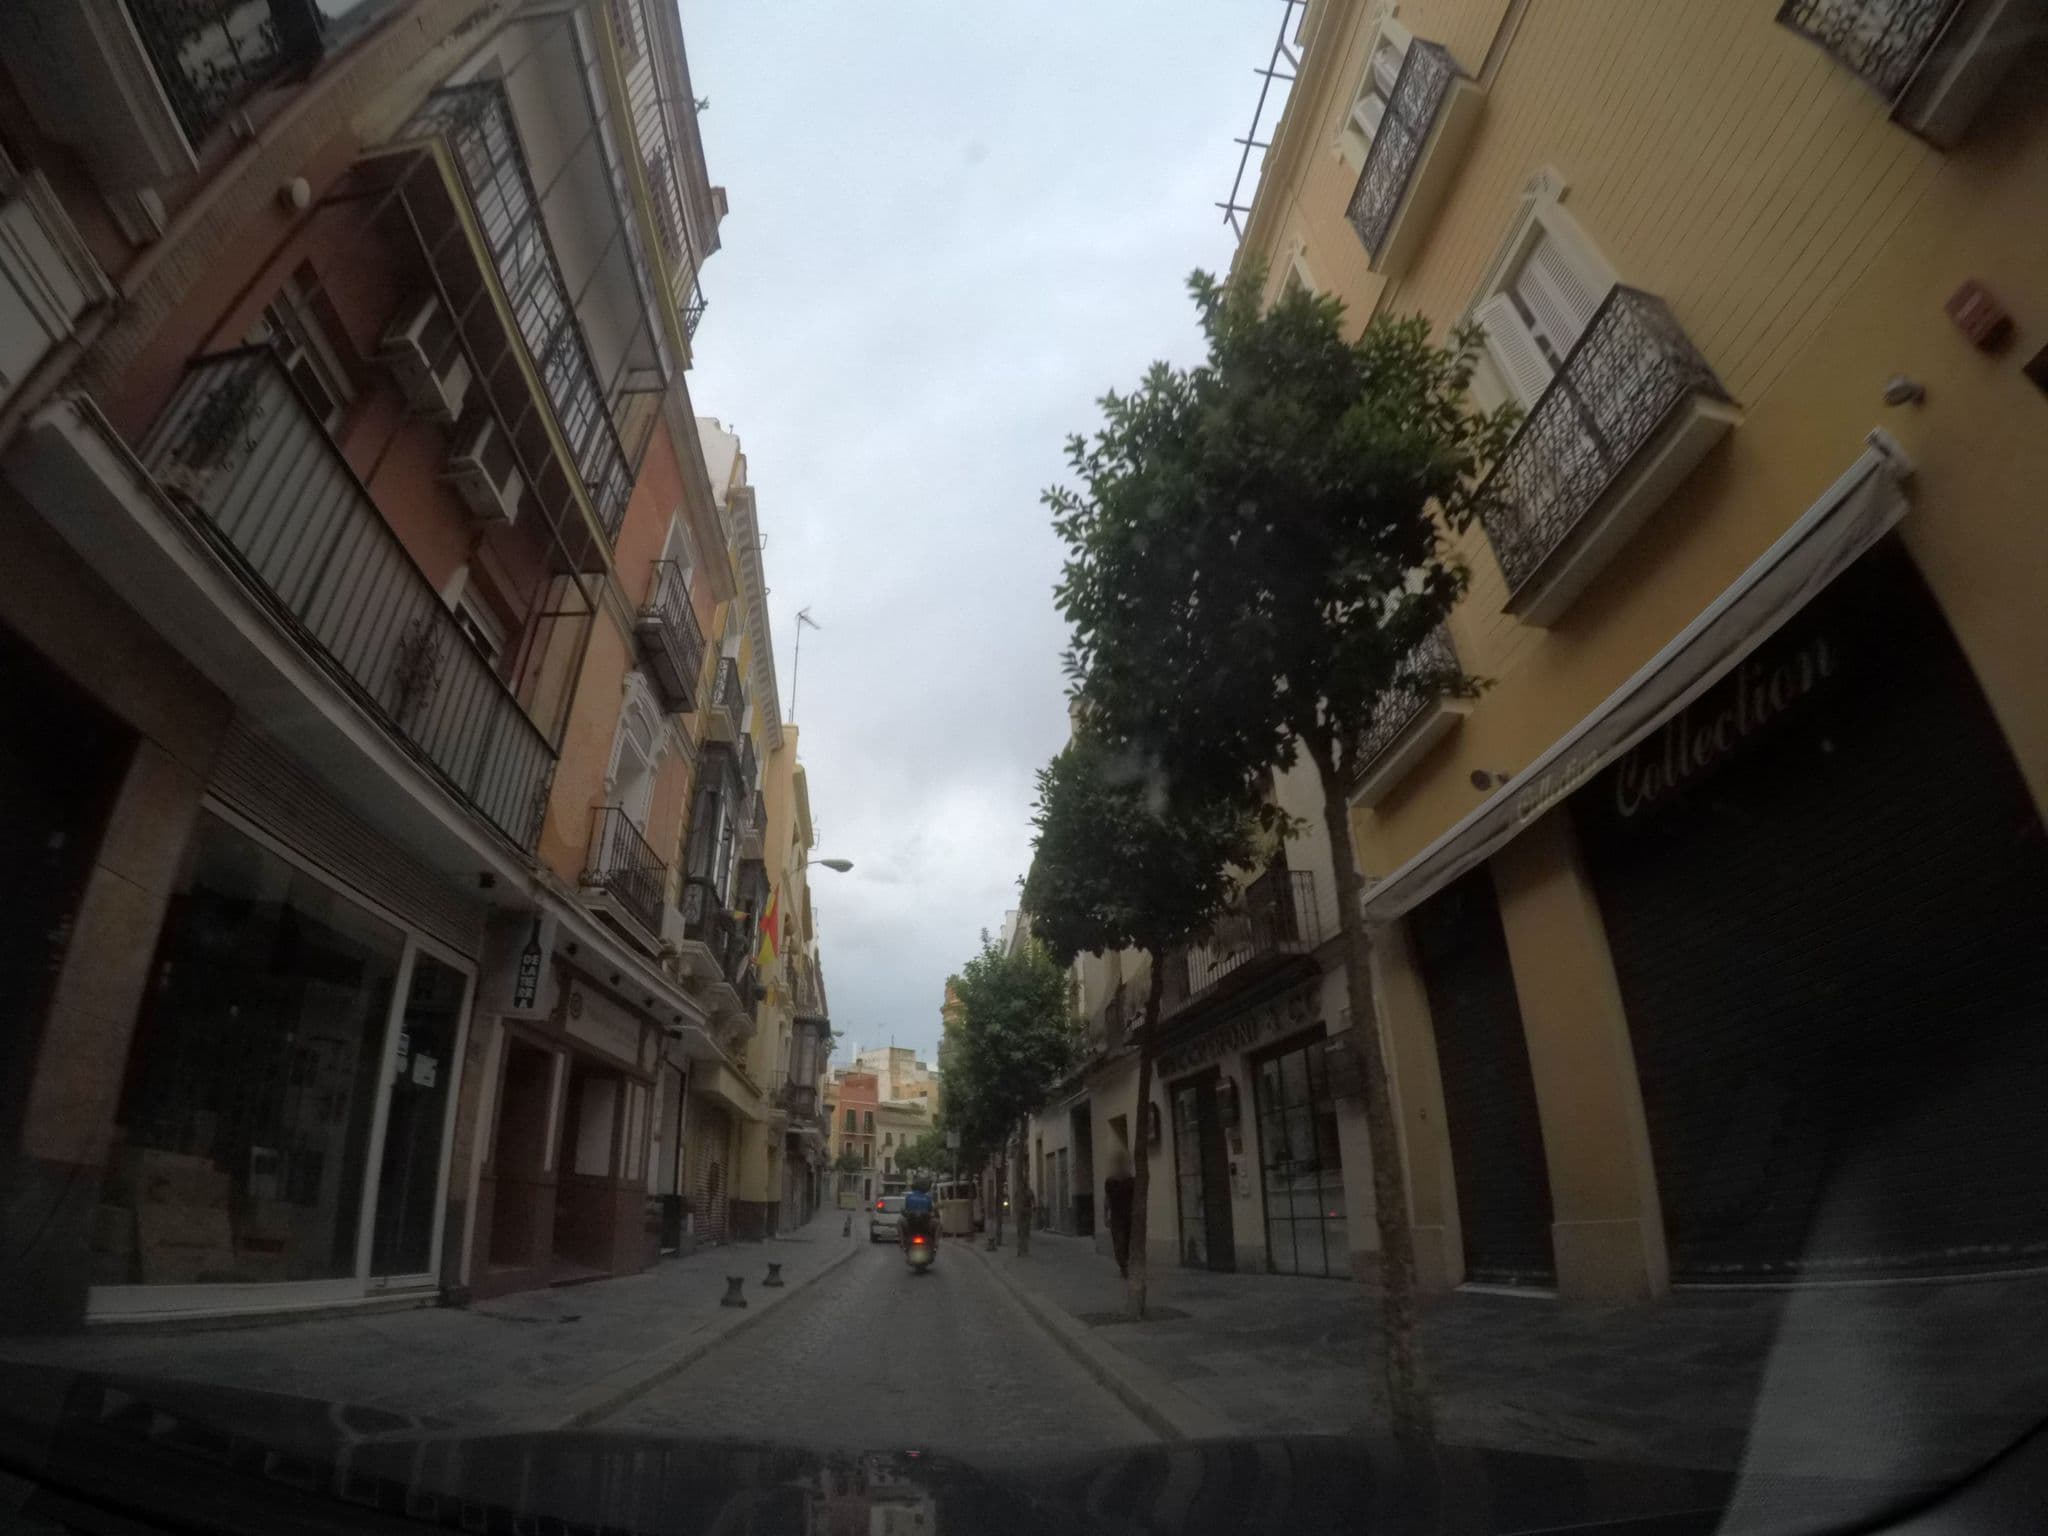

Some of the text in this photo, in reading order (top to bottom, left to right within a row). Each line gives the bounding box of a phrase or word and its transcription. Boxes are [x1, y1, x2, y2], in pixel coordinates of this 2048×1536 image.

[1616, 637, 1838, 817] Collection
[523, 953, 540, 966] DE
[520, 965, 537, 976] LA
